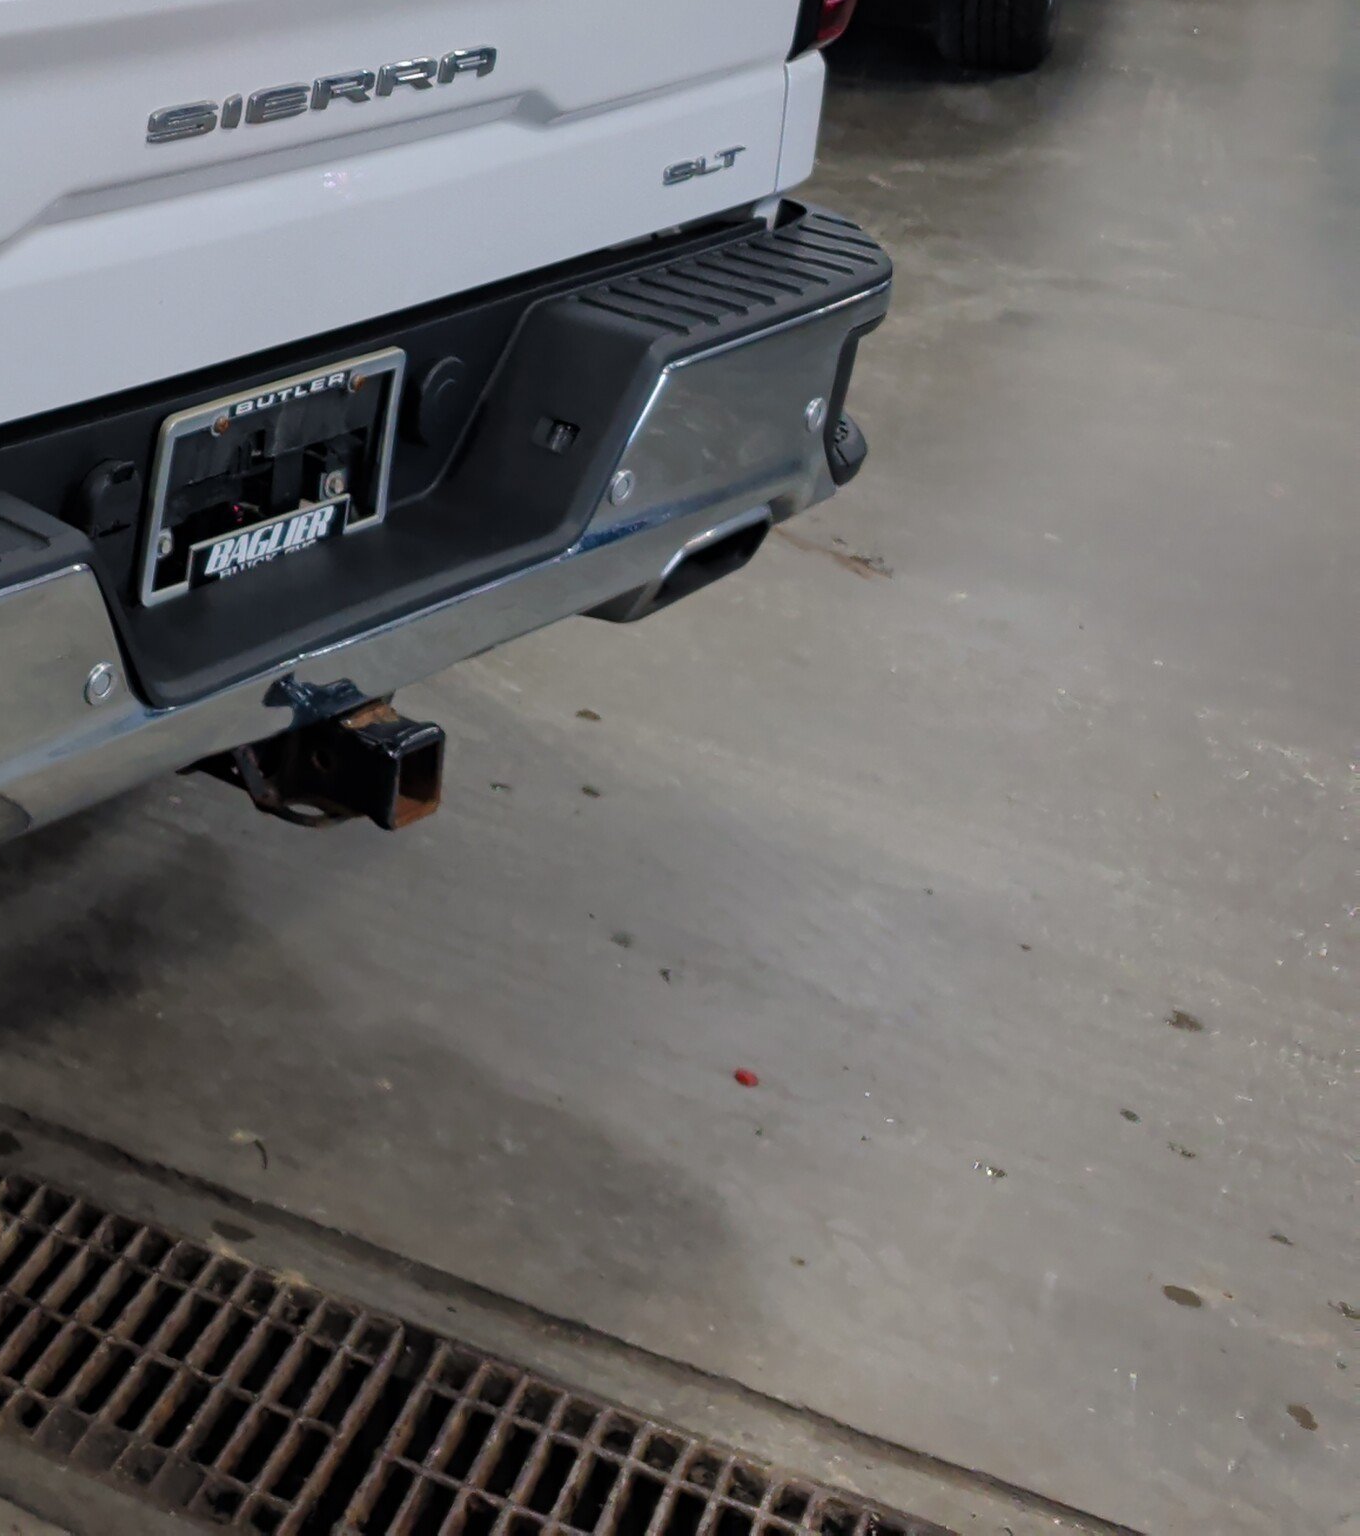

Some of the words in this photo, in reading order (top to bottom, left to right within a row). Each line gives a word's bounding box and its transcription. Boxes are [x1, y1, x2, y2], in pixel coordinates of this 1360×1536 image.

[146, 44, 498, 144] SIERRA
[663, 145, 746, 186] SLT
[234, 372, 346, 415] BUTLER
[204, 504, 335, 576] BAGLIER
